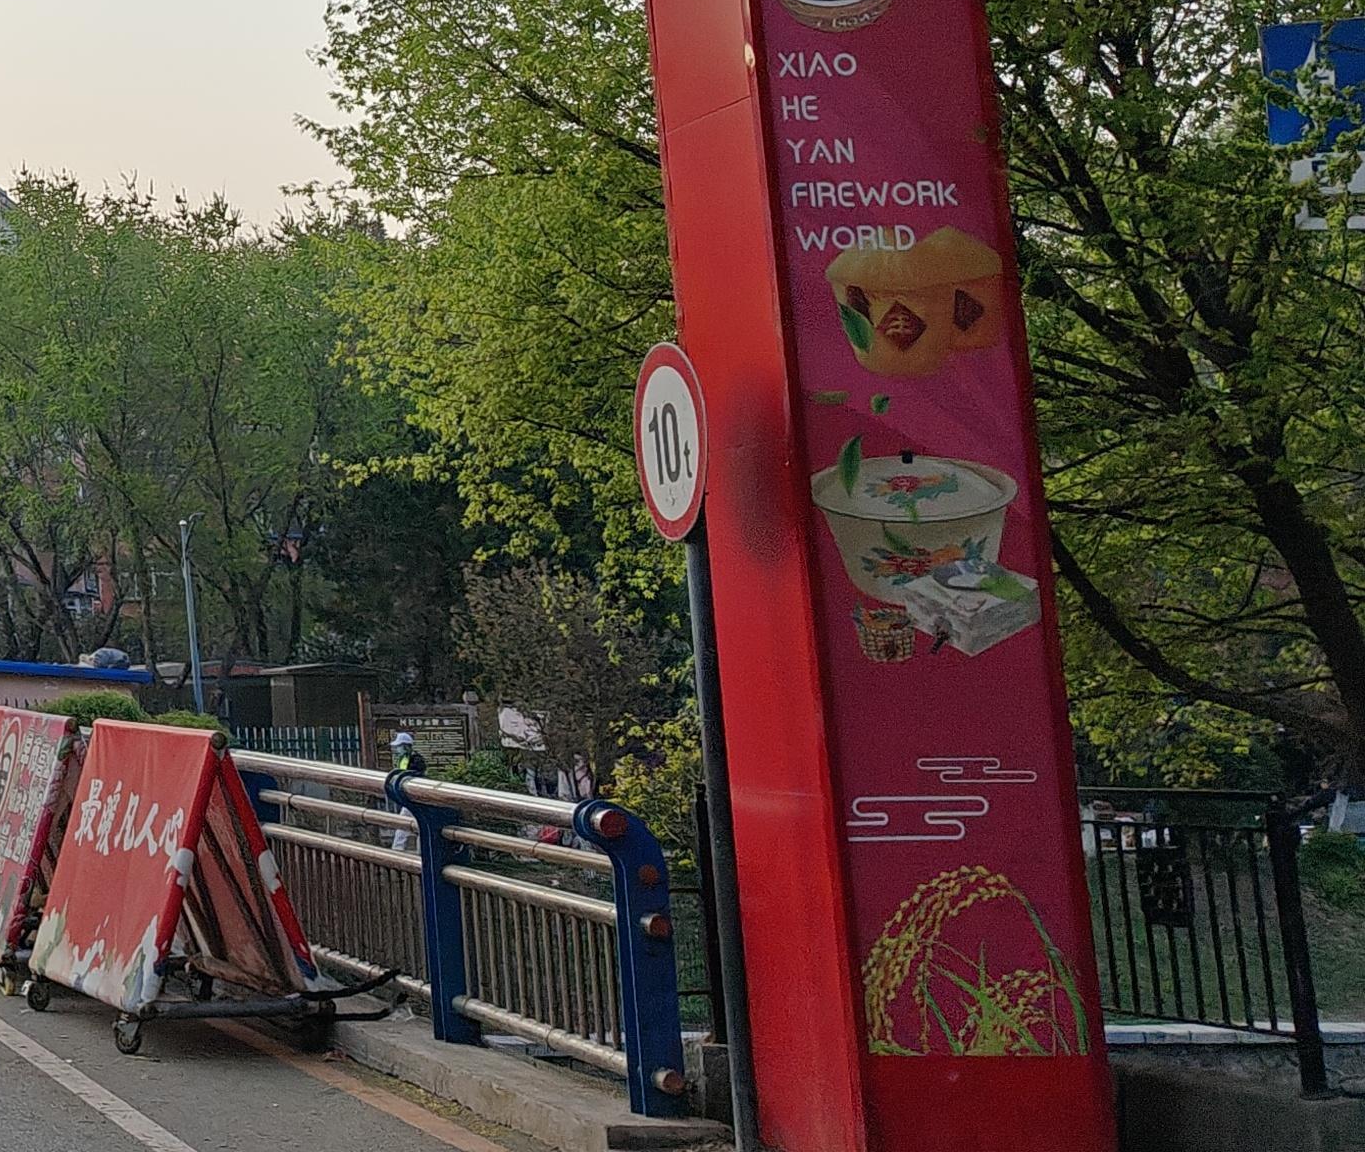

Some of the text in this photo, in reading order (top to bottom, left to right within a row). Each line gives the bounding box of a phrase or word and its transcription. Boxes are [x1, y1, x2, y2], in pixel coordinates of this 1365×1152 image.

[777, 51, 858, 78] XIAO
[781, 95, 819, 122] HE
[785, 137, 855, 164] YAN
[790, 179, 959, 209] FIREWORK
[795, 223, 916, 252] WORLD
